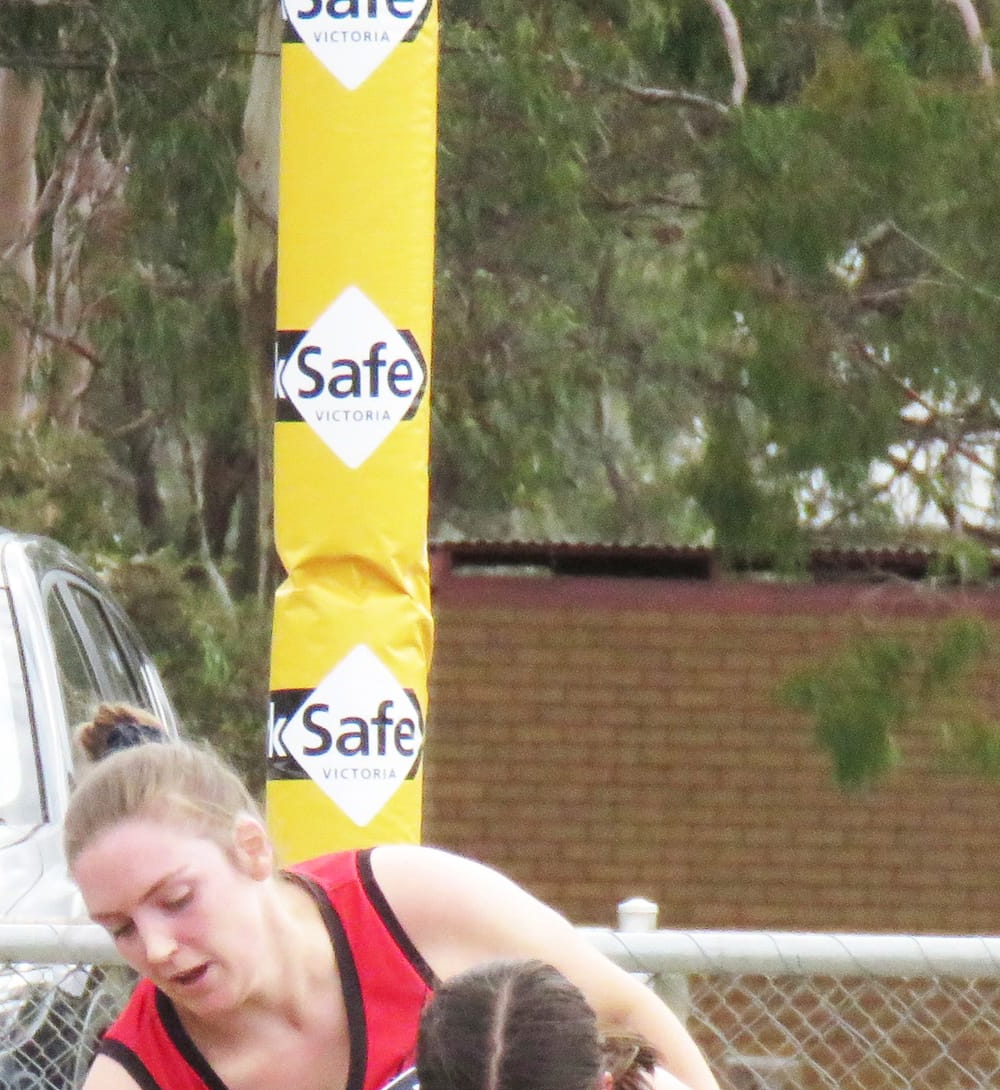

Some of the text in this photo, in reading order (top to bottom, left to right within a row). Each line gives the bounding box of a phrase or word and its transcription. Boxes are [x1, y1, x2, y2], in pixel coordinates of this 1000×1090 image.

[313, 31, 391, 43] VICTORIA
[315, 410, 391, 422] VICTORIA
[322, 768, 397, 780] VICTORIA
